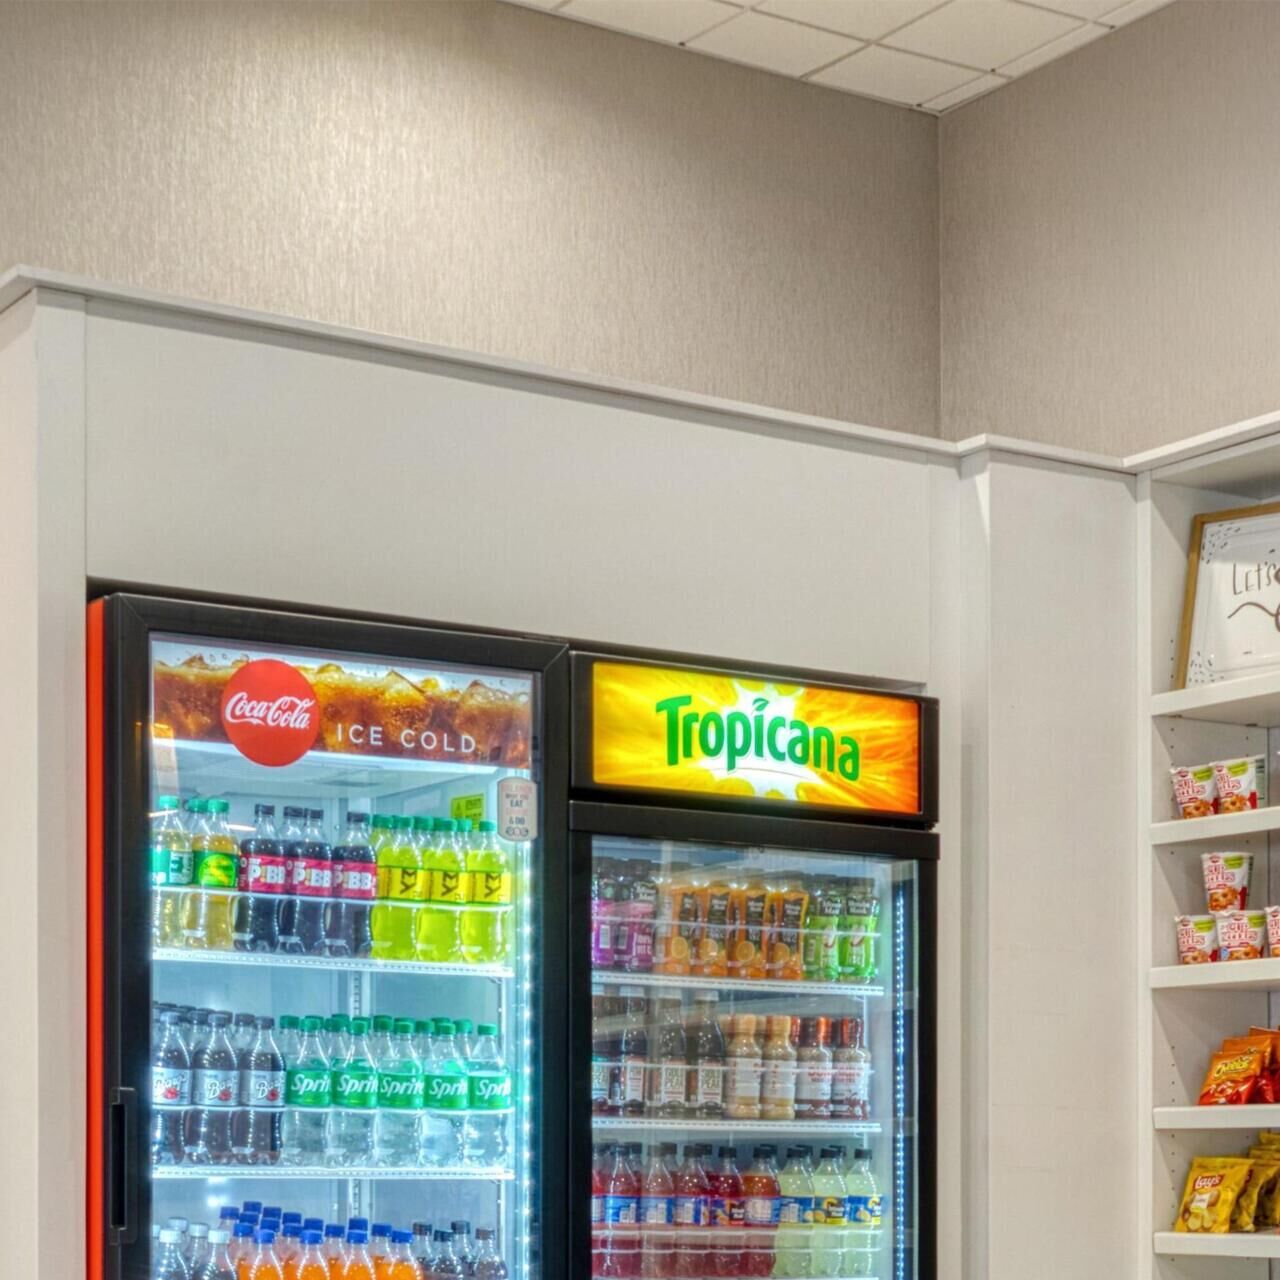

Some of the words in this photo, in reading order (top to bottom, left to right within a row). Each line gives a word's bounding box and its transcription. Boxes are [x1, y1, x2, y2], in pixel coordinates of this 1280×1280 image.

[225, 691, 315, 729] Coca-Cola
[336, 724, 383, 746] ICE
[400, 727, 477, 753] COLD
[655, 694, 860, 782] Tropicana
